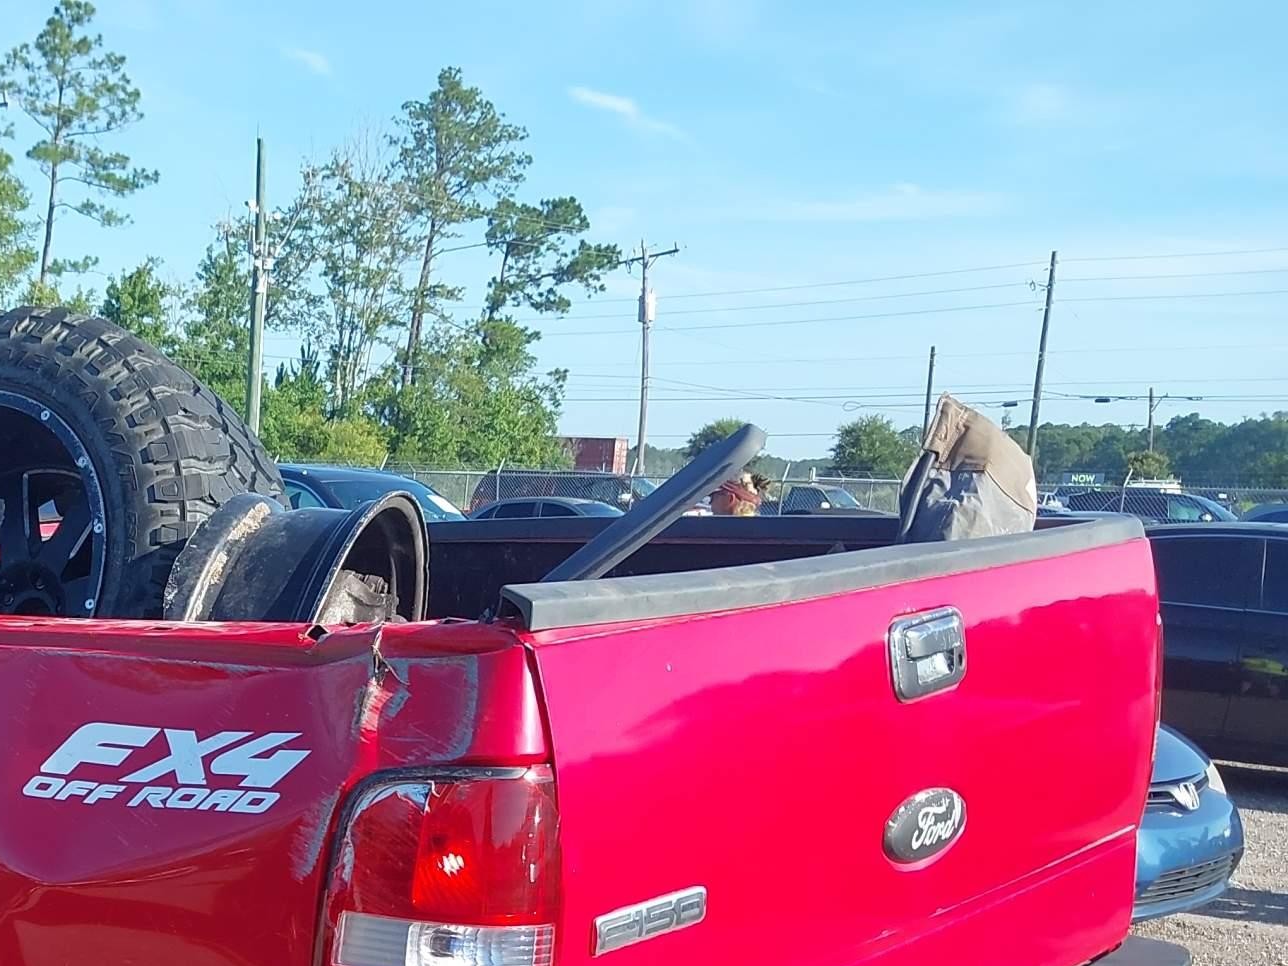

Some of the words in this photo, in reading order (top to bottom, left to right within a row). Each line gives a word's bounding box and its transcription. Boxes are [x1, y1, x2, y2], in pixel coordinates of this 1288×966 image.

[1071, 473, 1095, 482] NOW
[40, 721, 312, 788] FX4
[22, 775, 128, 804] OFF
[126, 786, 281, 814] ROAD
[911, 798, 959, 850] Ford
